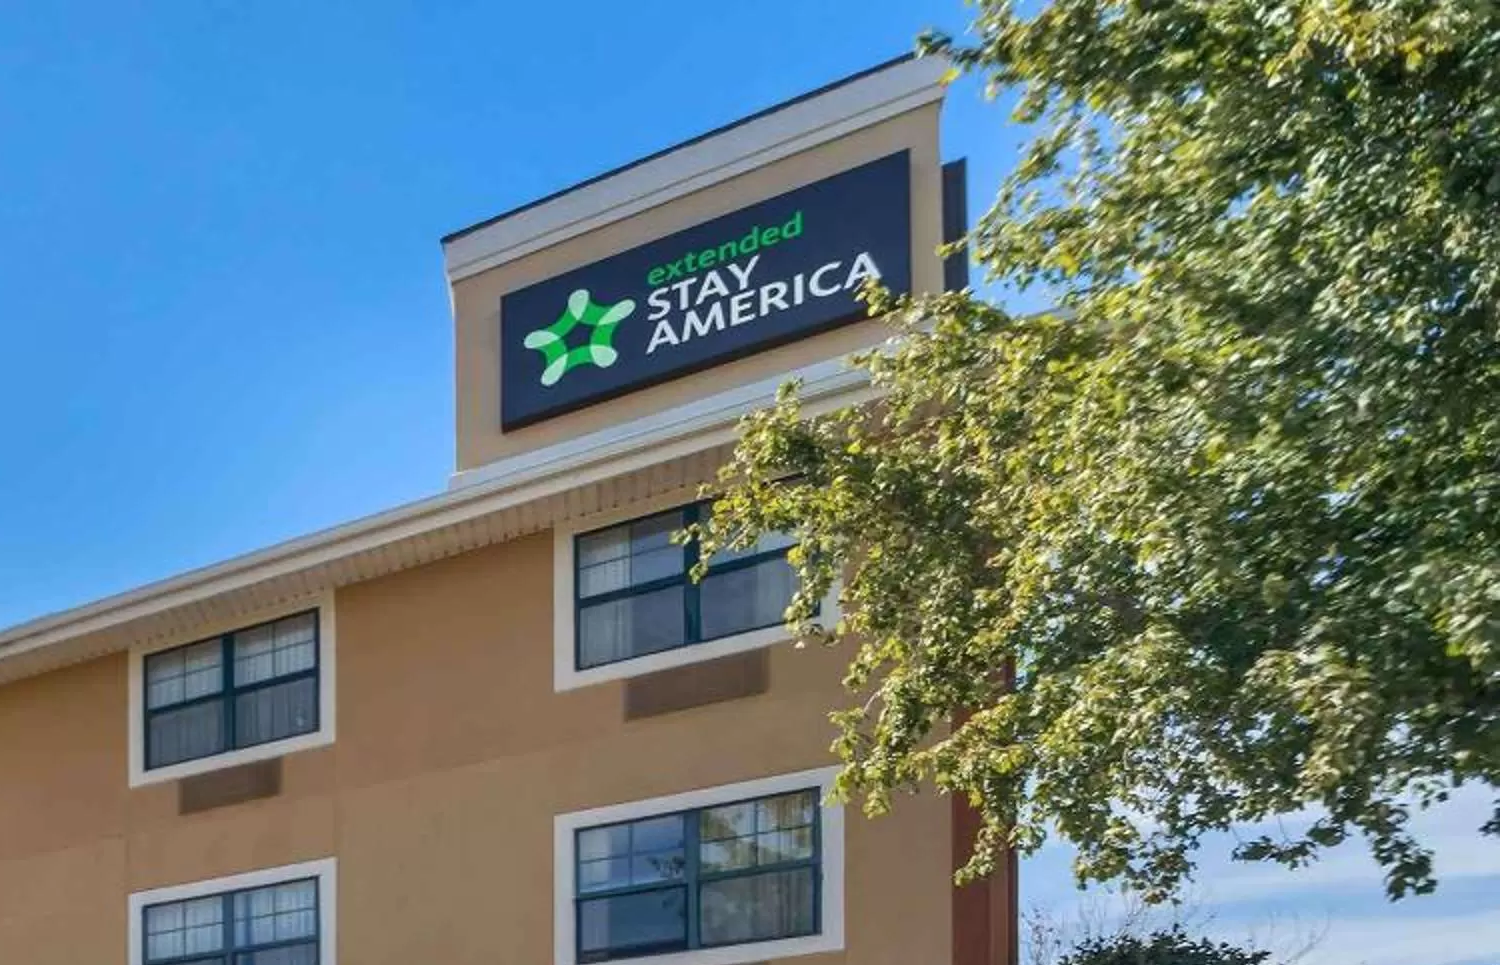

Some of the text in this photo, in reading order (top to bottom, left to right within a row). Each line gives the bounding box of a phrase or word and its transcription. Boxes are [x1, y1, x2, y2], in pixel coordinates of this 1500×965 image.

[647, 211, 804, 285] extended
[646, 251, 882, 354] AMERICA
[647, 254, 760, 321] STAY
